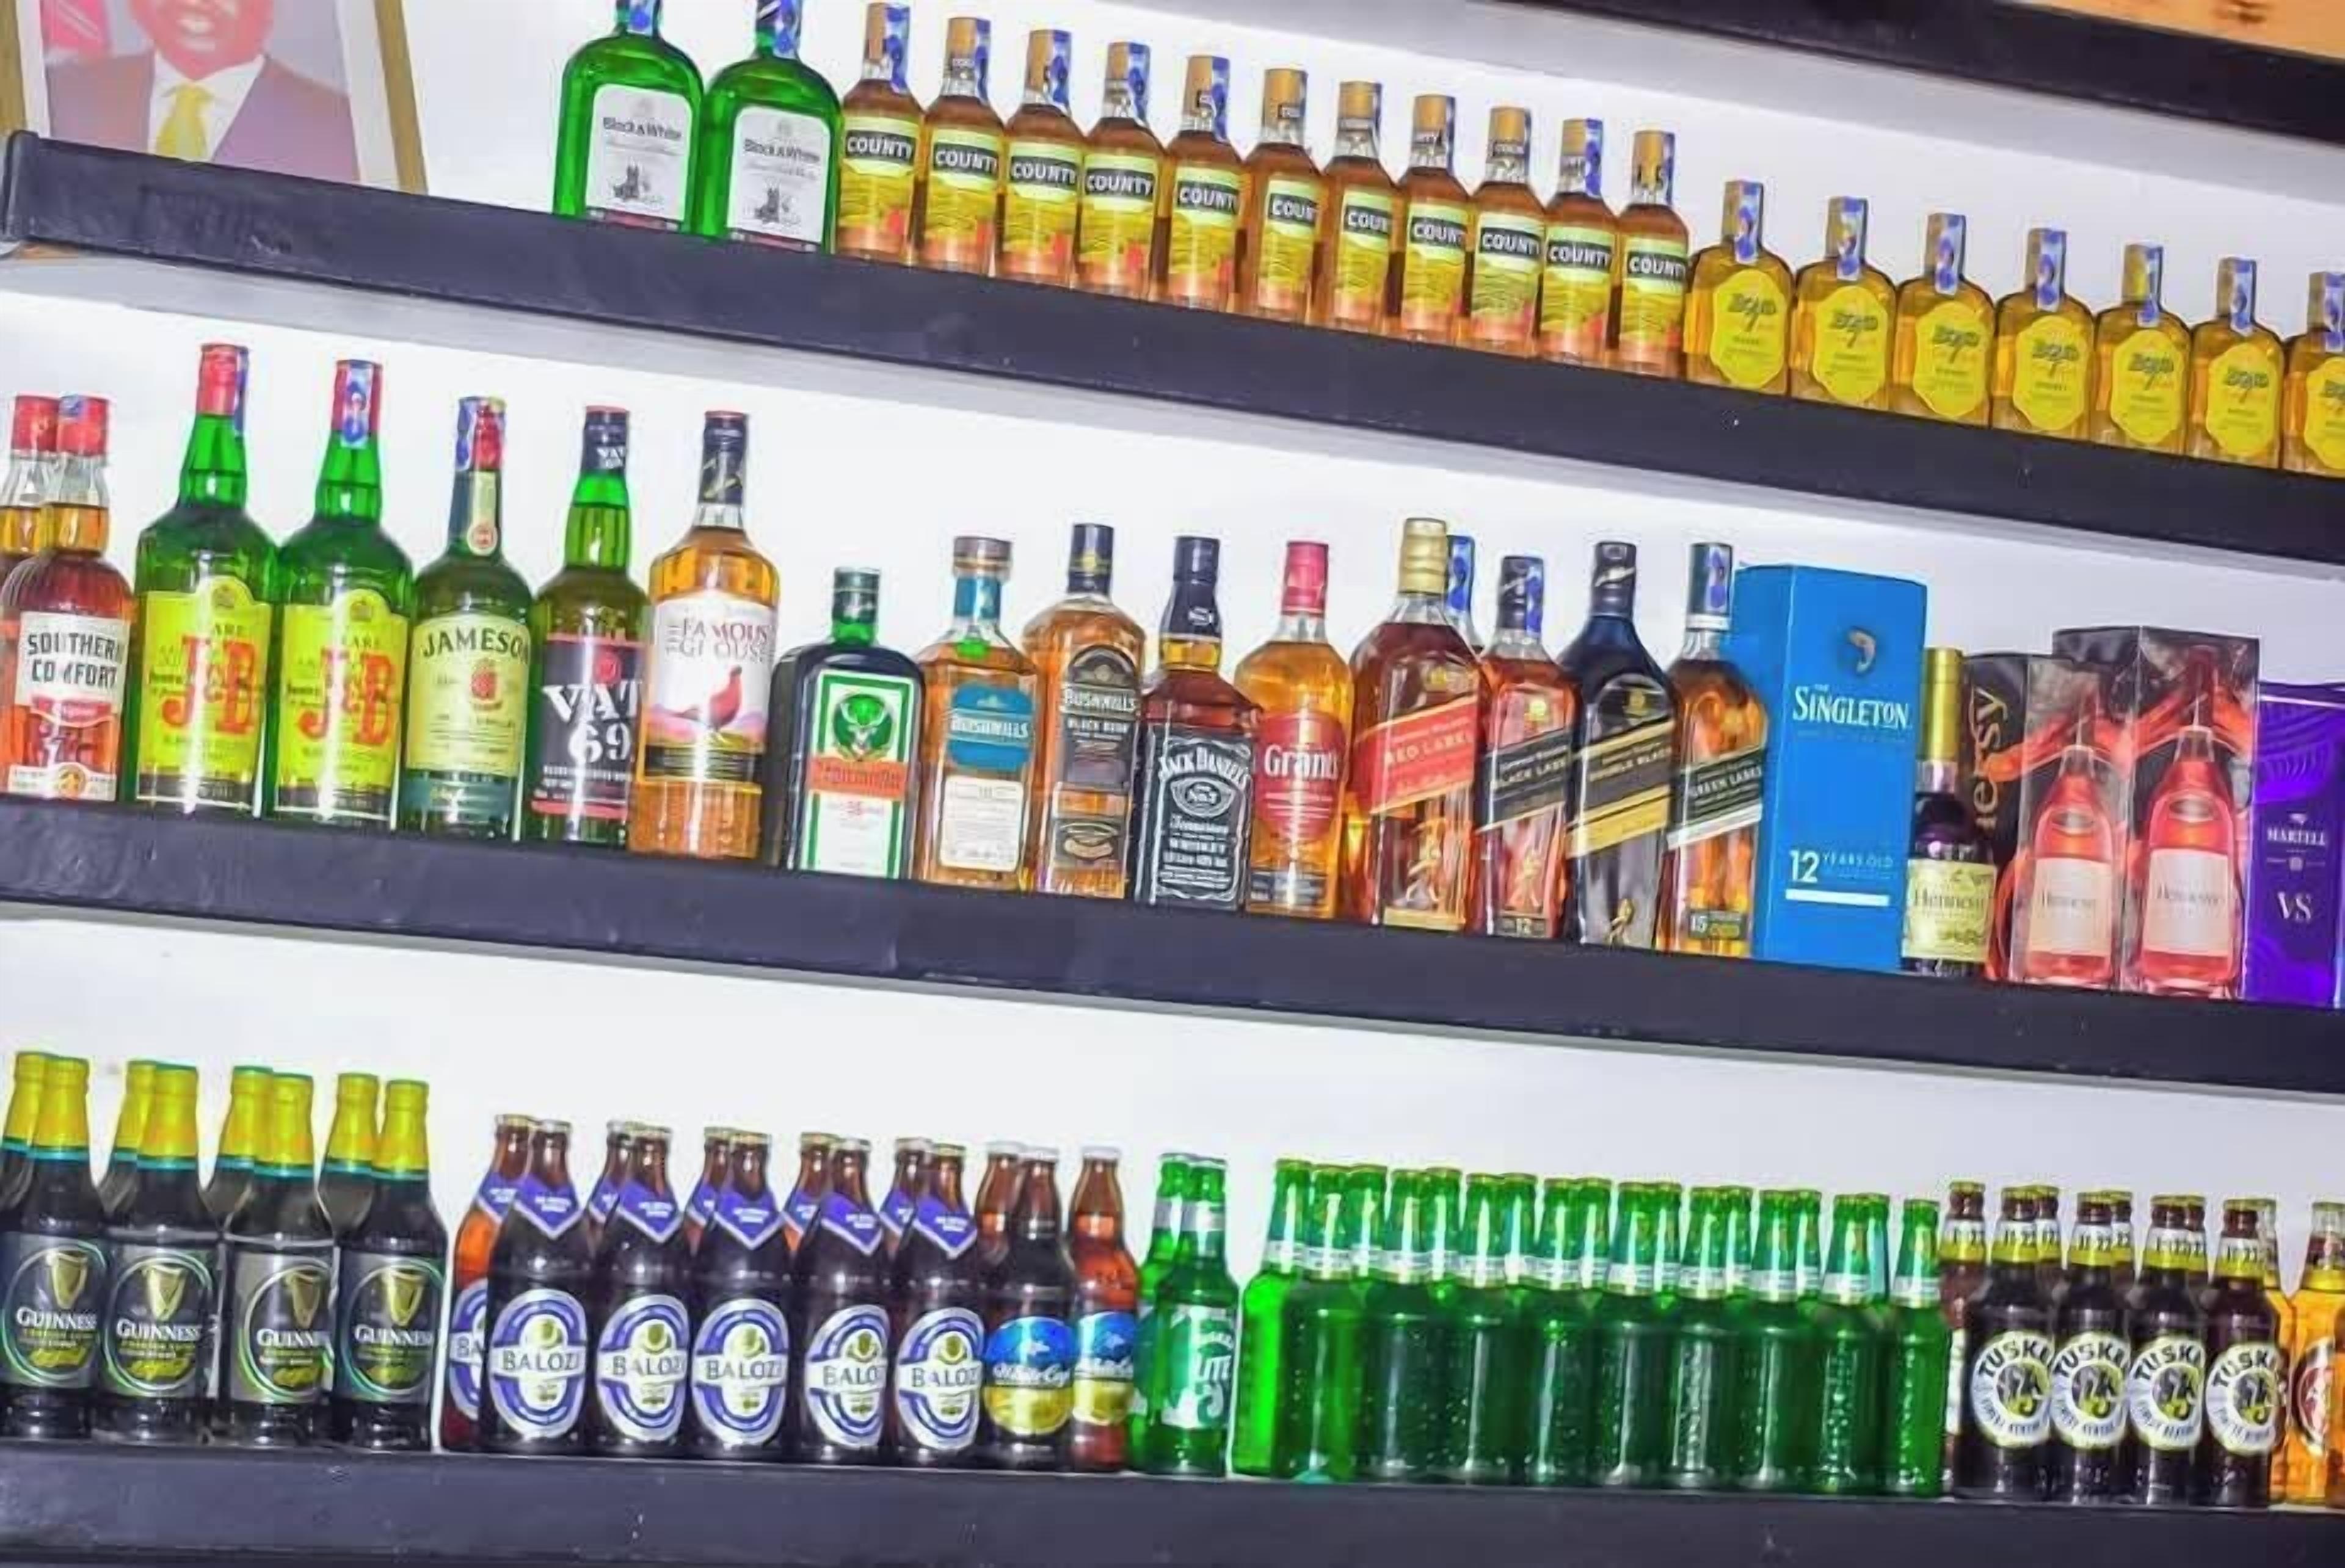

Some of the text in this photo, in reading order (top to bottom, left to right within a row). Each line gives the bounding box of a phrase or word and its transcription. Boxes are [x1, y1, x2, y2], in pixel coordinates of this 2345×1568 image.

[1792, 685, 1911, 731] SINGLETON
[567, 722, 632, 763] 69
[1789, 849, 1820, 884] 12
[2276, 890, 2313, 923] VS
